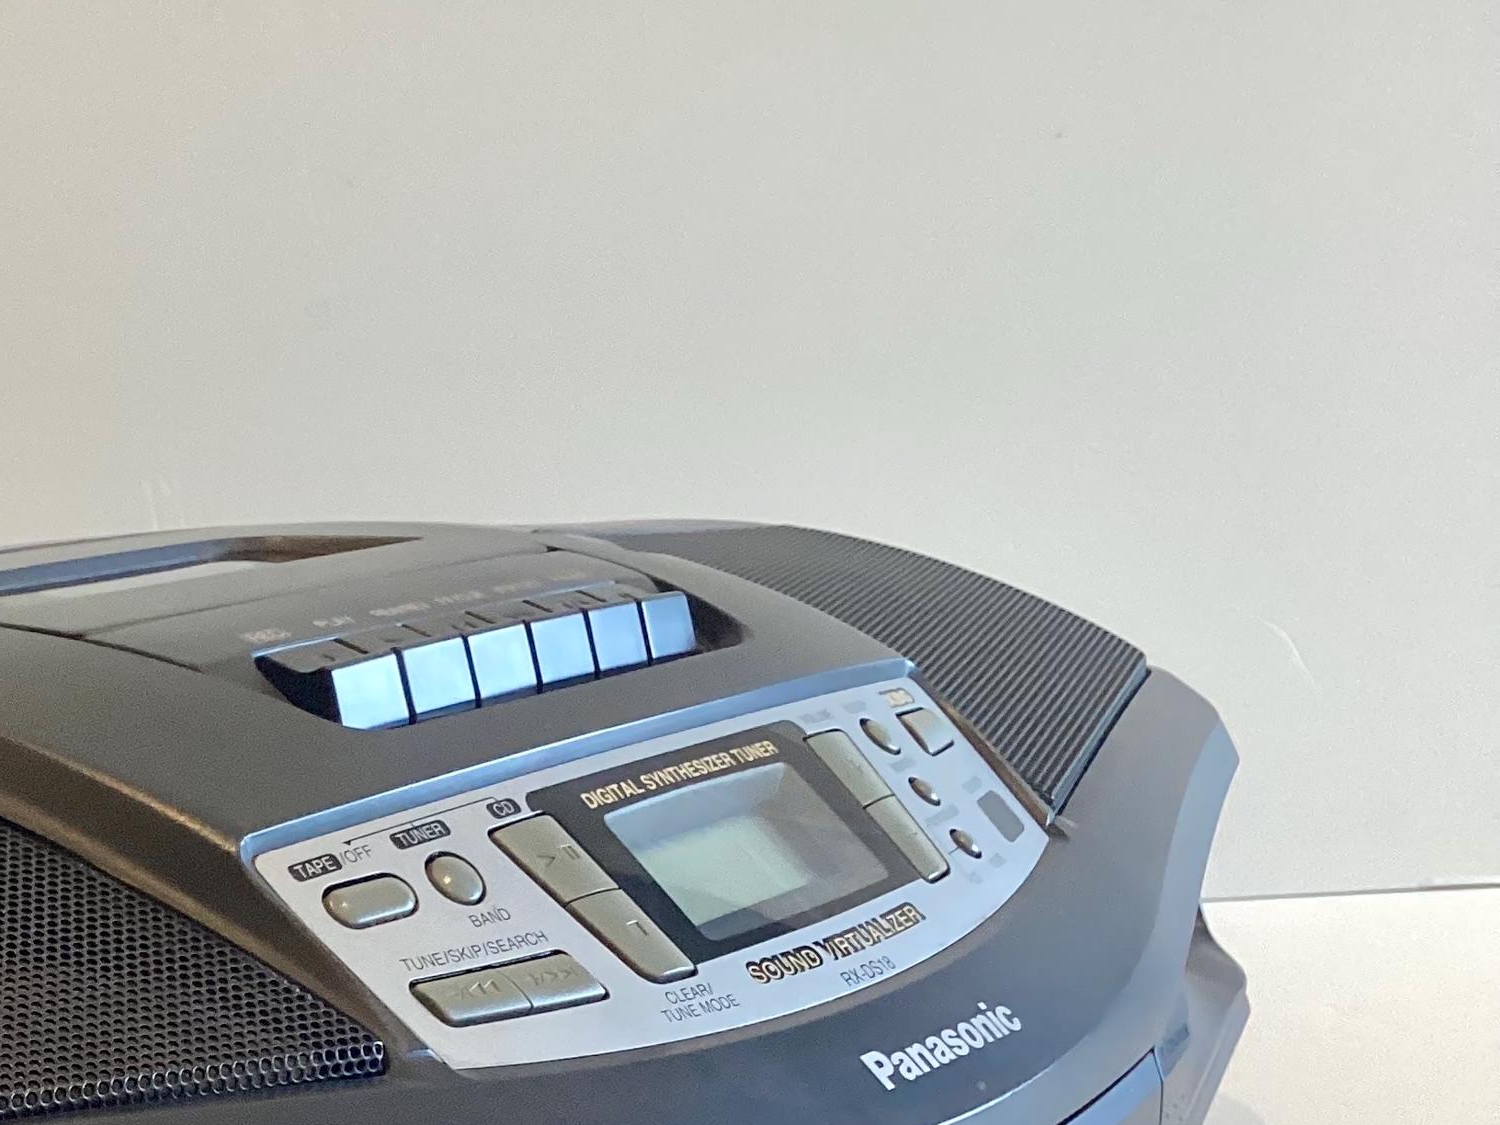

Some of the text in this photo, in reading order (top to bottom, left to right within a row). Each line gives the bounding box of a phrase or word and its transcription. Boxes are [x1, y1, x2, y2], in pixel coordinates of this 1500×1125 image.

[580, 740, 780, 809] DIGITAL SYNTHESIZER TUNER
[490, 800, 516, 817] CD
[392, 822, 445, 846] TUNER
[468, 907, 512, 928] BAND
[399, 930, 549, 972] TUNE/SKIP/SEARCH
[746, 902, 927, 984] SOUND VIRTUALIZER
[840, 955, 897, 987] RX-DS18
[665, 982, 713, 1004] CLEAR/
[660, 994, 741, 1023] TUNE MODE
[860, 1001, 1022, 1091] Panasonic
